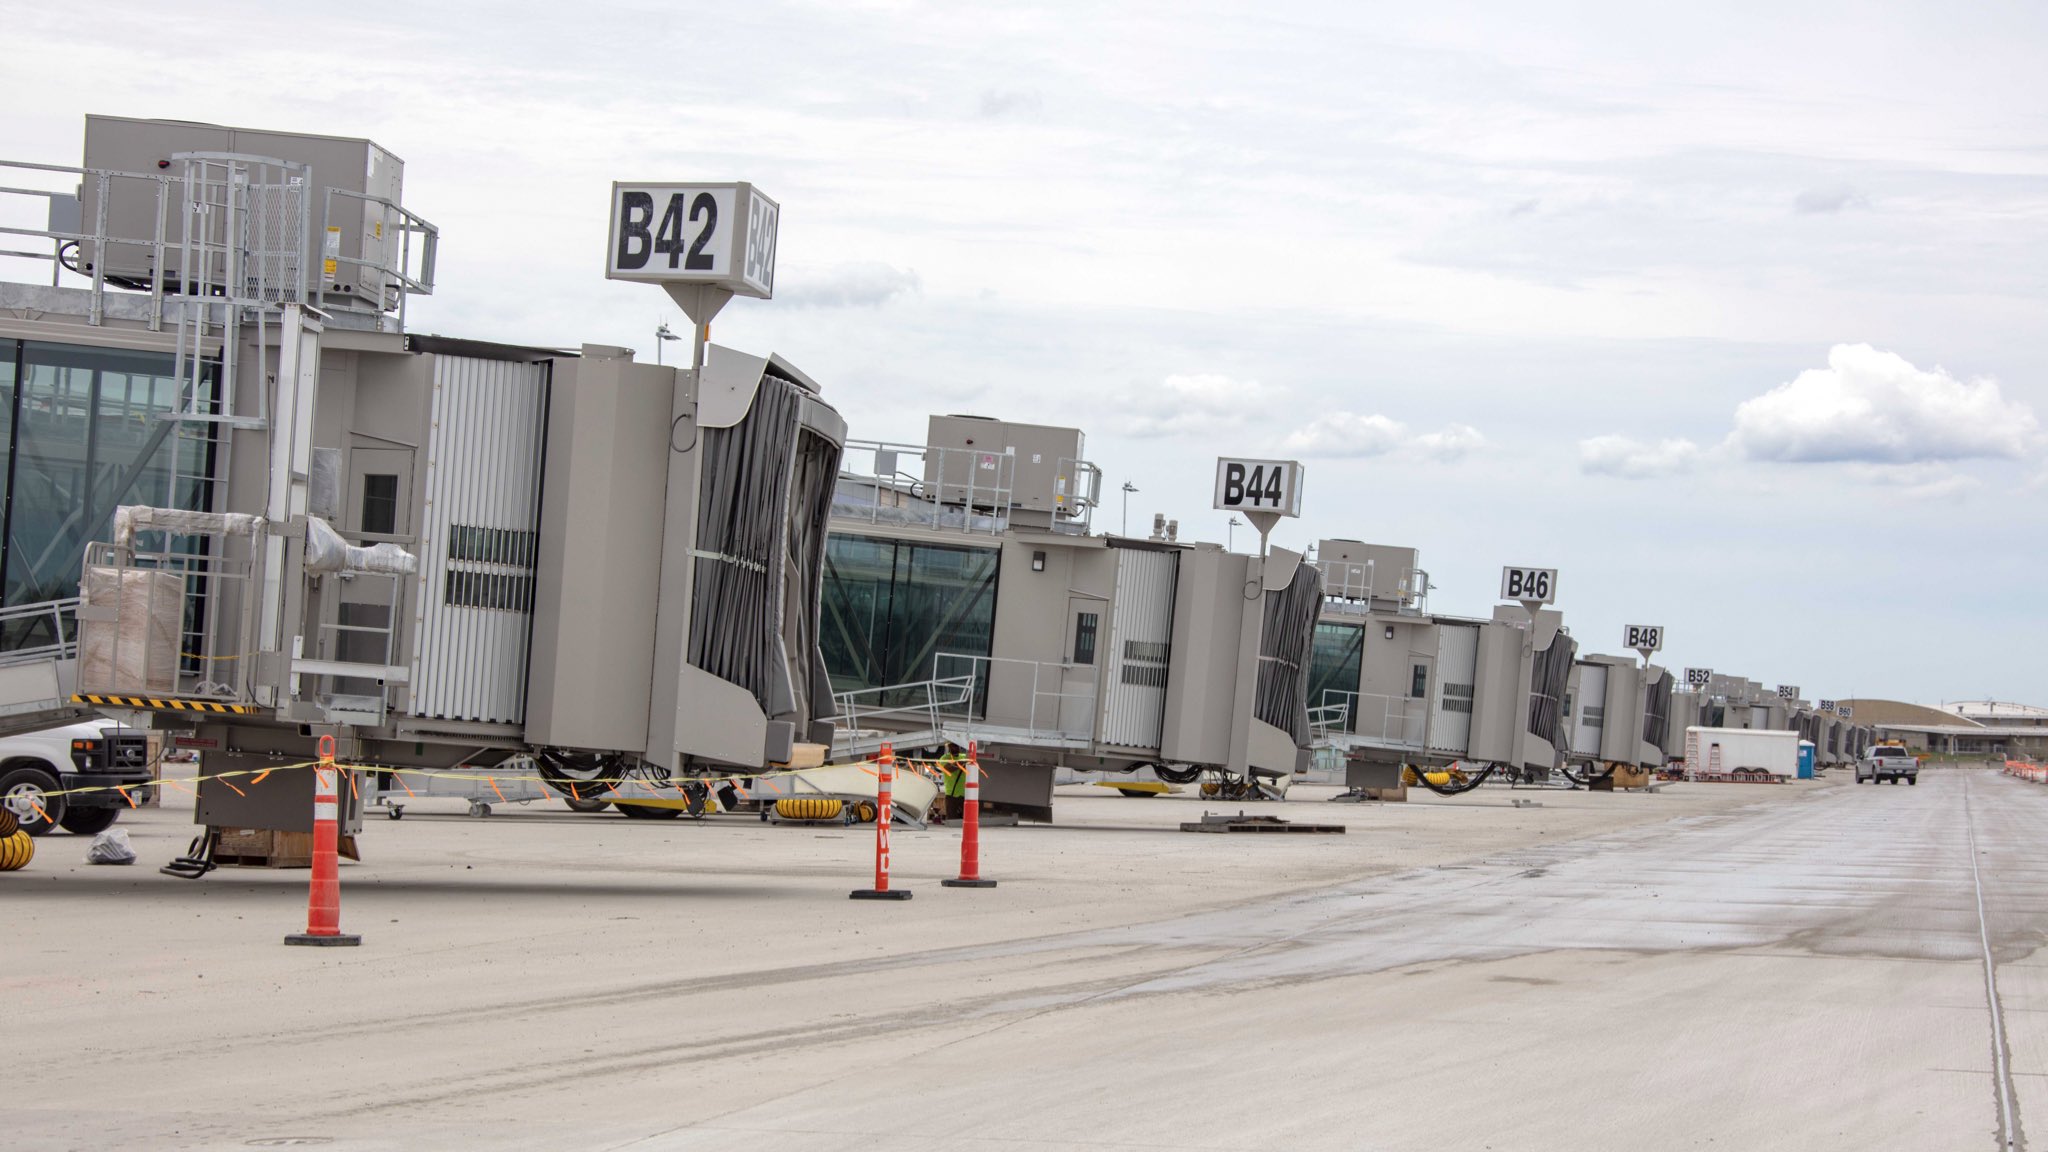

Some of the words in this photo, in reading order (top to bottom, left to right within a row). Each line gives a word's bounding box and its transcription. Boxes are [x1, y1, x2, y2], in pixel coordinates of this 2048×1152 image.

[617, 191, 718, 270] B42
[746, 196, 775, 288] B42
[1224, 463, 1282, 507] B44
[1508, 569, 1548, 599] B46
[1629, 627, 1657, 647] B48
[1688, 669, 1709, 683] B52
[1779, 686, 1793, 697] B54
[1821, 700, 1834, 710] B58
